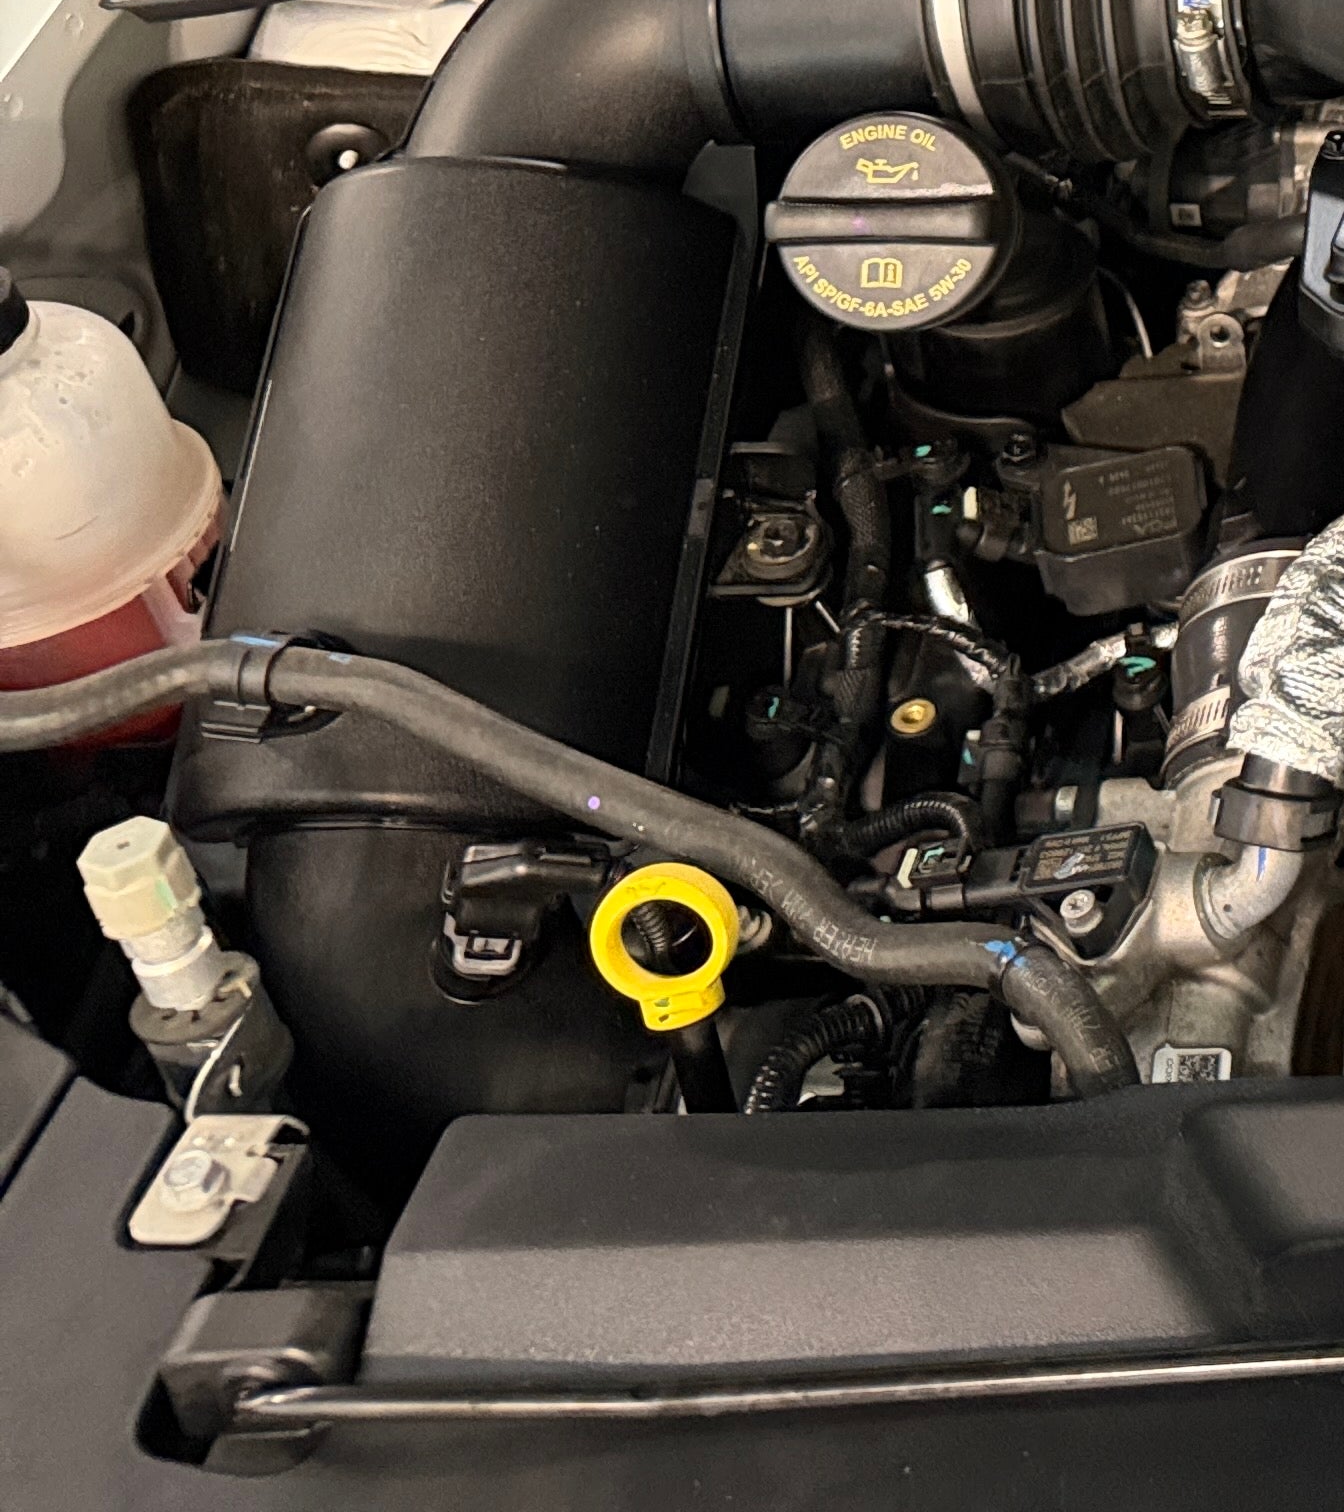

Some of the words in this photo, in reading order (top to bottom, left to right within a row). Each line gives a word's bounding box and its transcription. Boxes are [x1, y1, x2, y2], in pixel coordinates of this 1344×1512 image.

[838, 124, 908, 151] ENGINE
[909, 124, 938, 152] OIL
[793, 254, 818, 284] API
[930, 258, 972, 301] 5W-30
